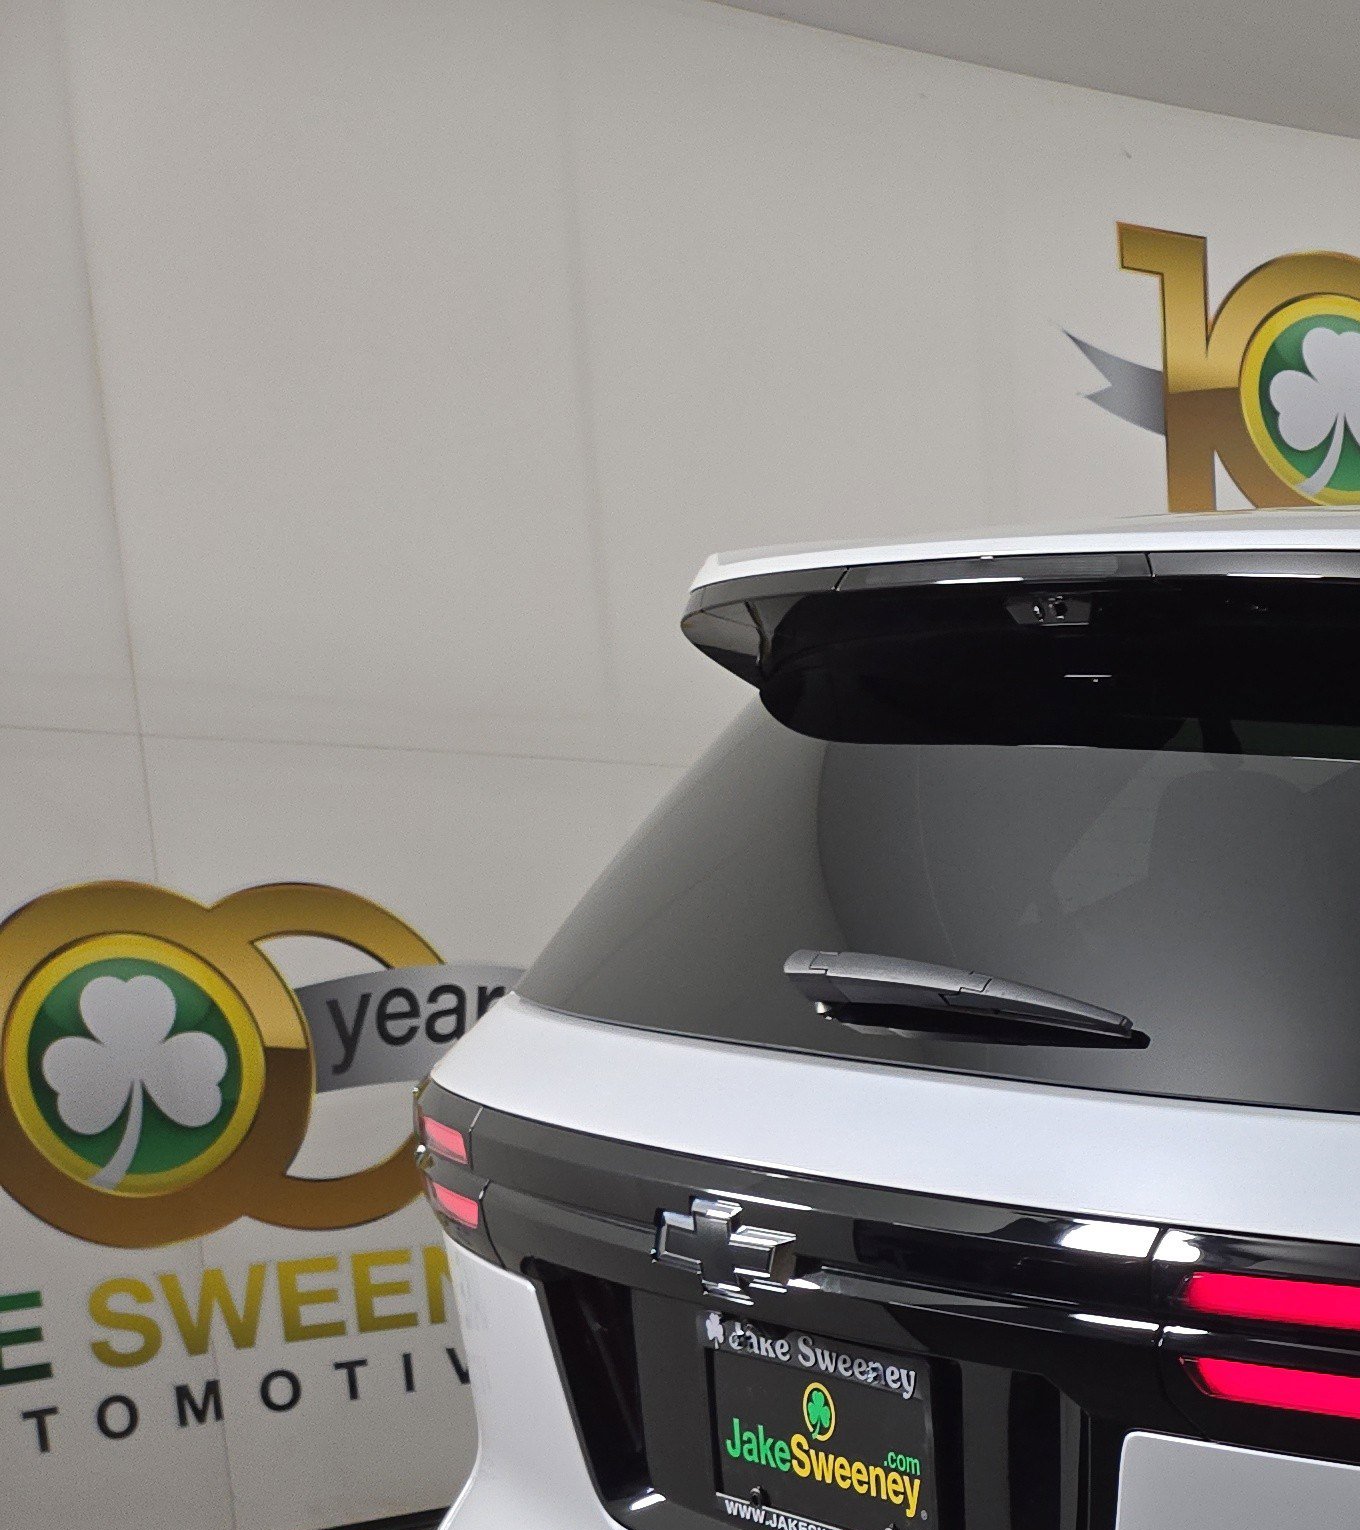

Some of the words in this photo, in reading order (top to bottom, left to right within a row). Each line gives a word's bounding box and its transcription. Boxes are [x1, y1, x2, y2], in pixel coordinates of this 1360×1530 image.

[728, 1321, 793, 1363] Jake
[797, 1334, 917, 1400] Sweeney
[883, 1450, 922, 1477] .com
